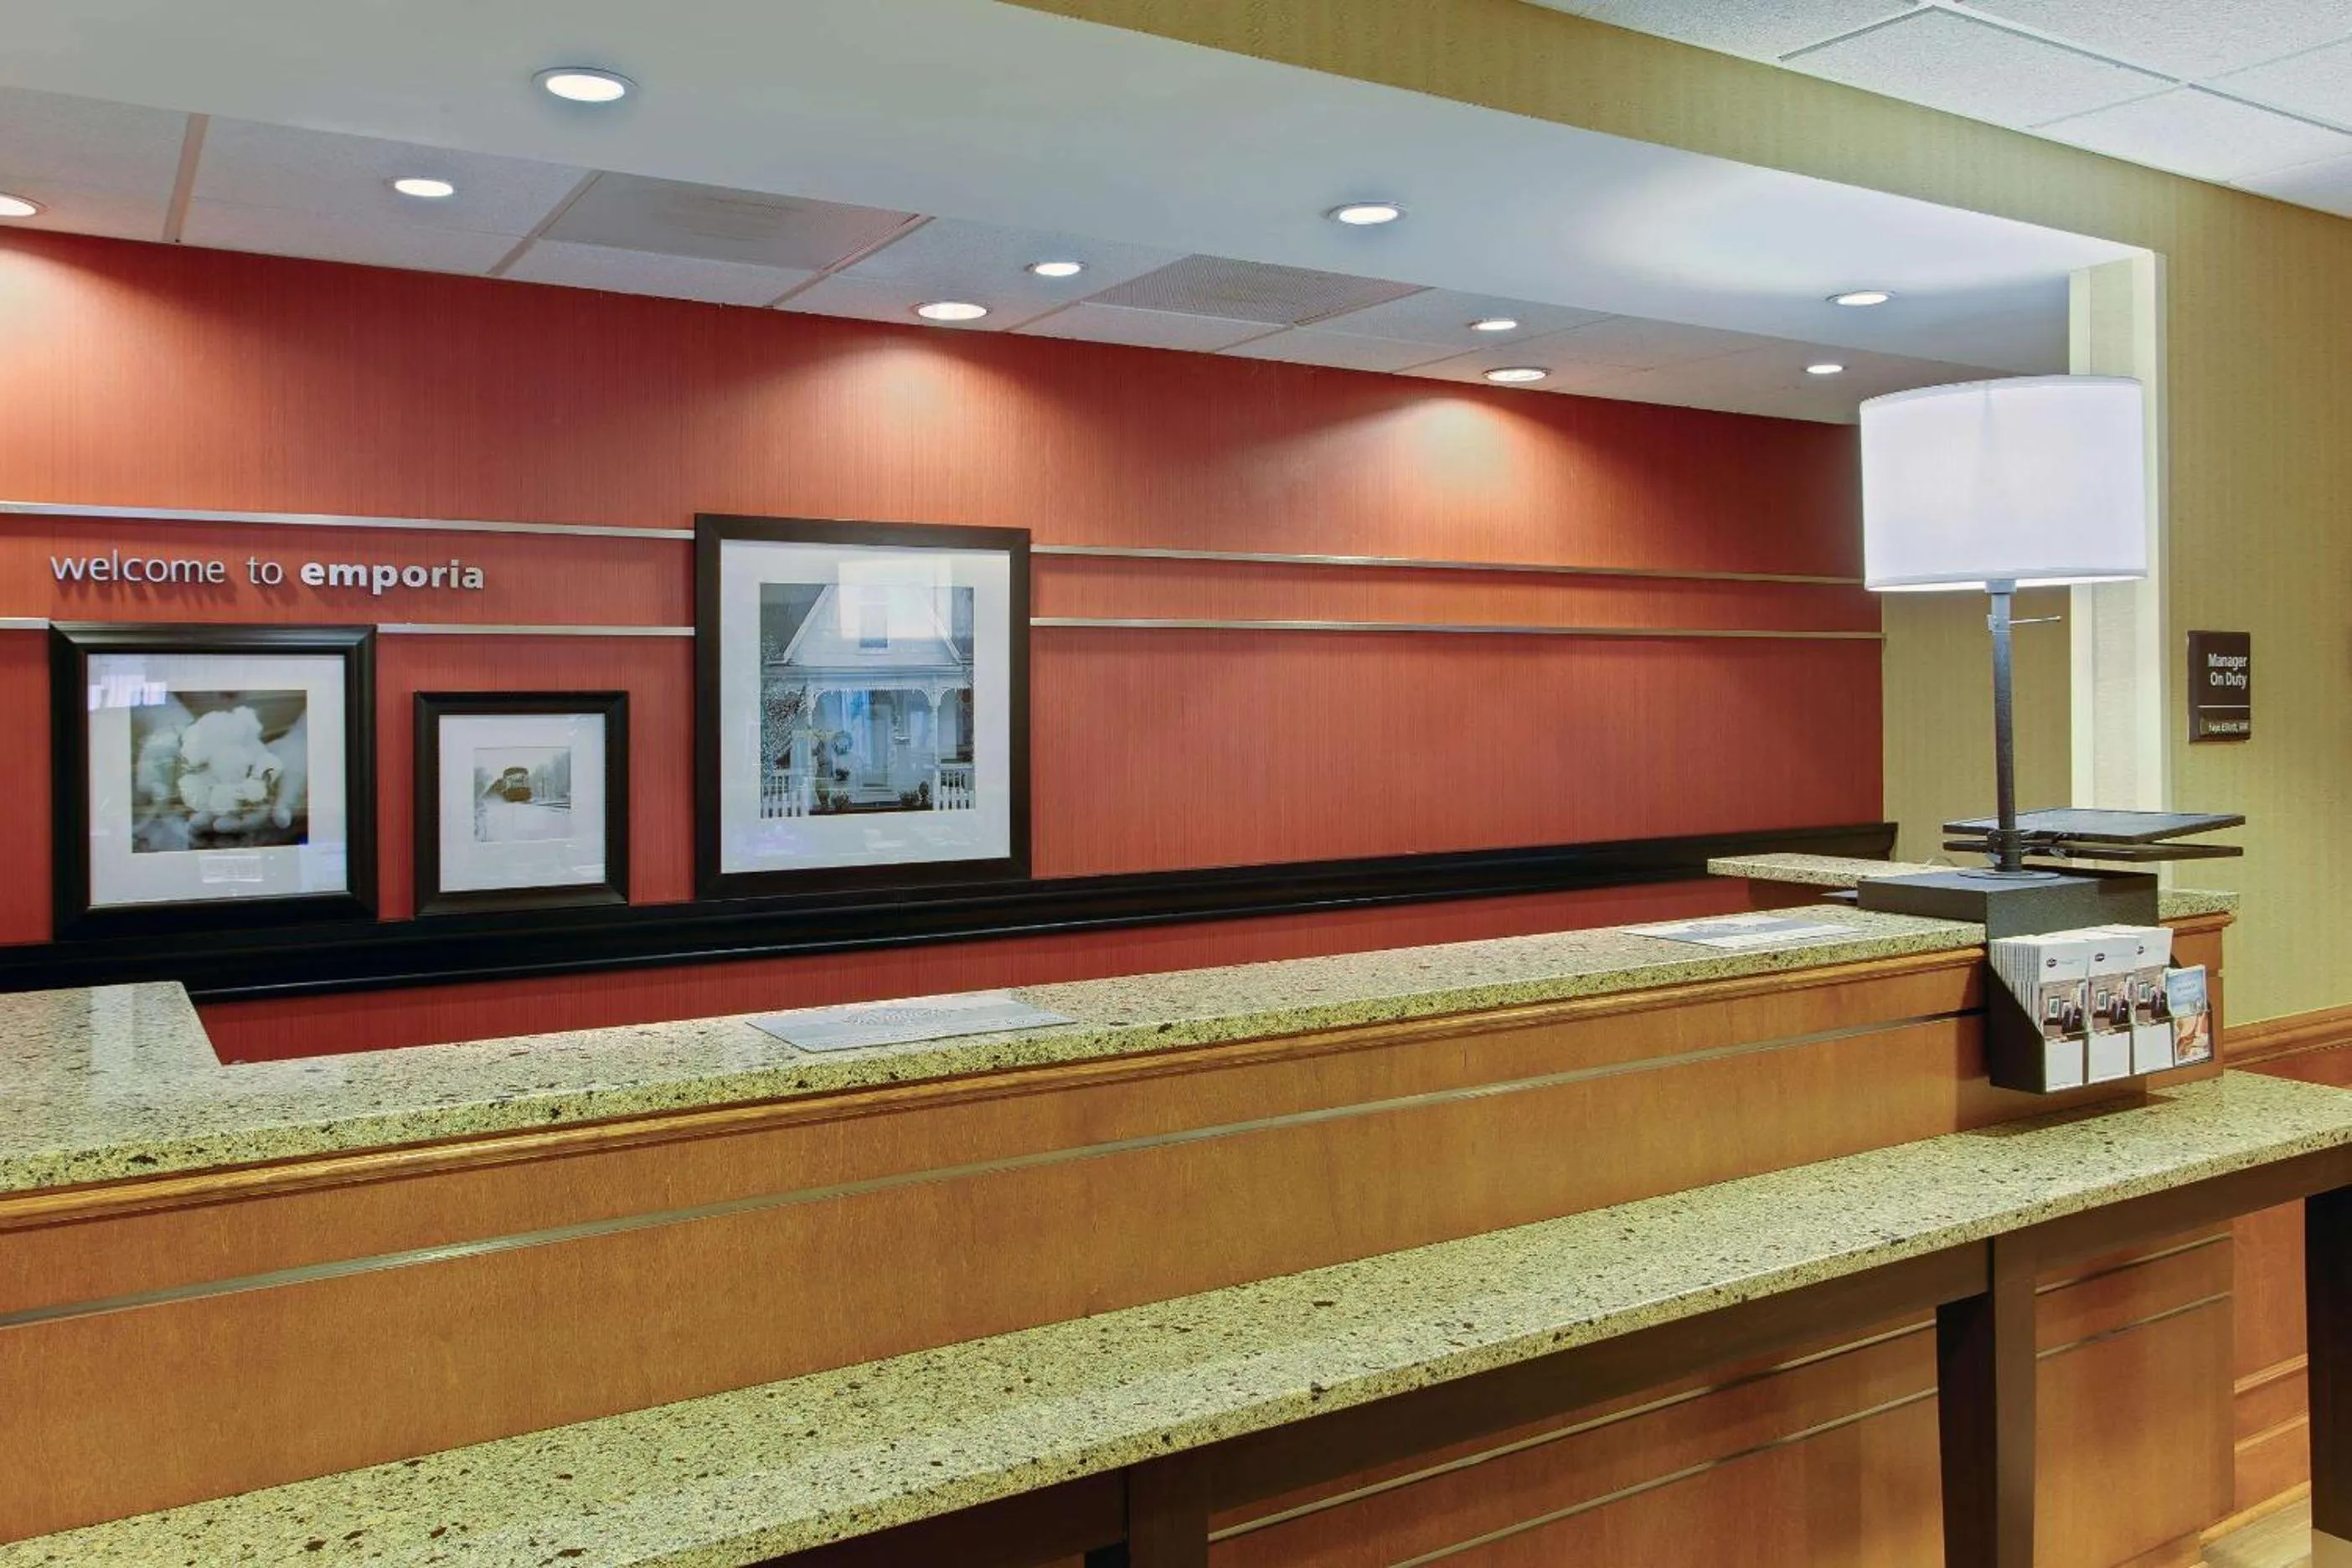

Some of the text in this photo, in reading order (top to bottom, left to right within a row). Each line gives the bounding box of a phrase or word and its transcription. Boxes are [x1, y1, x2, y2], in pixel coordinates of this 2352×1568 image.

[49, 549, 484, 595] welcome to emporia
[2208, 653, 2247, 670] Manager
[2210, 672, 2247, 689] On Duty
